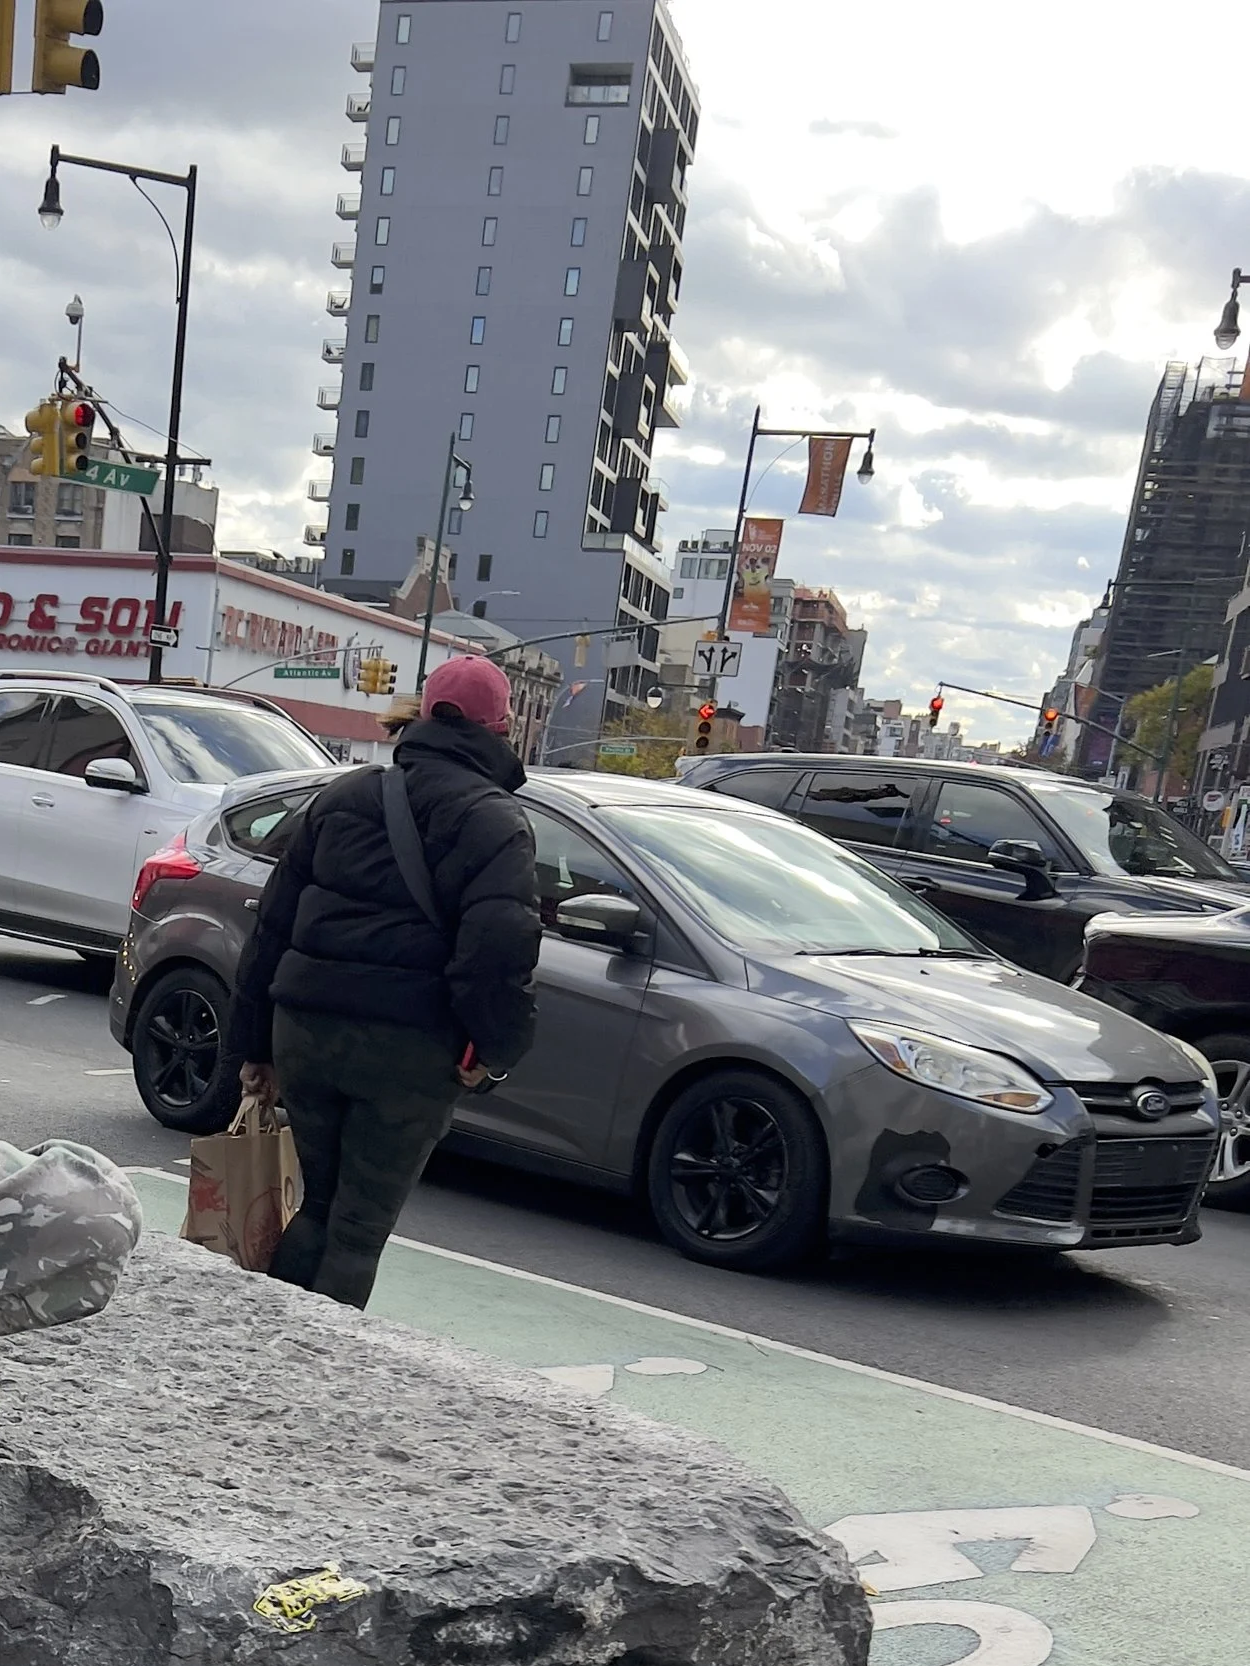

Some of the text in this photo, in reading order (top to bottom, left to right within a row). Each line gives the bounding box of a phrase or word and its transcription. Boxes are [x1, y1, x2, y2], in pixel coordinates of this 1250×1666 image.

[86, 465, 99, 480] 4
[742, 543, 777, 553] NOV 02
[27, 594, 59, 631] &
